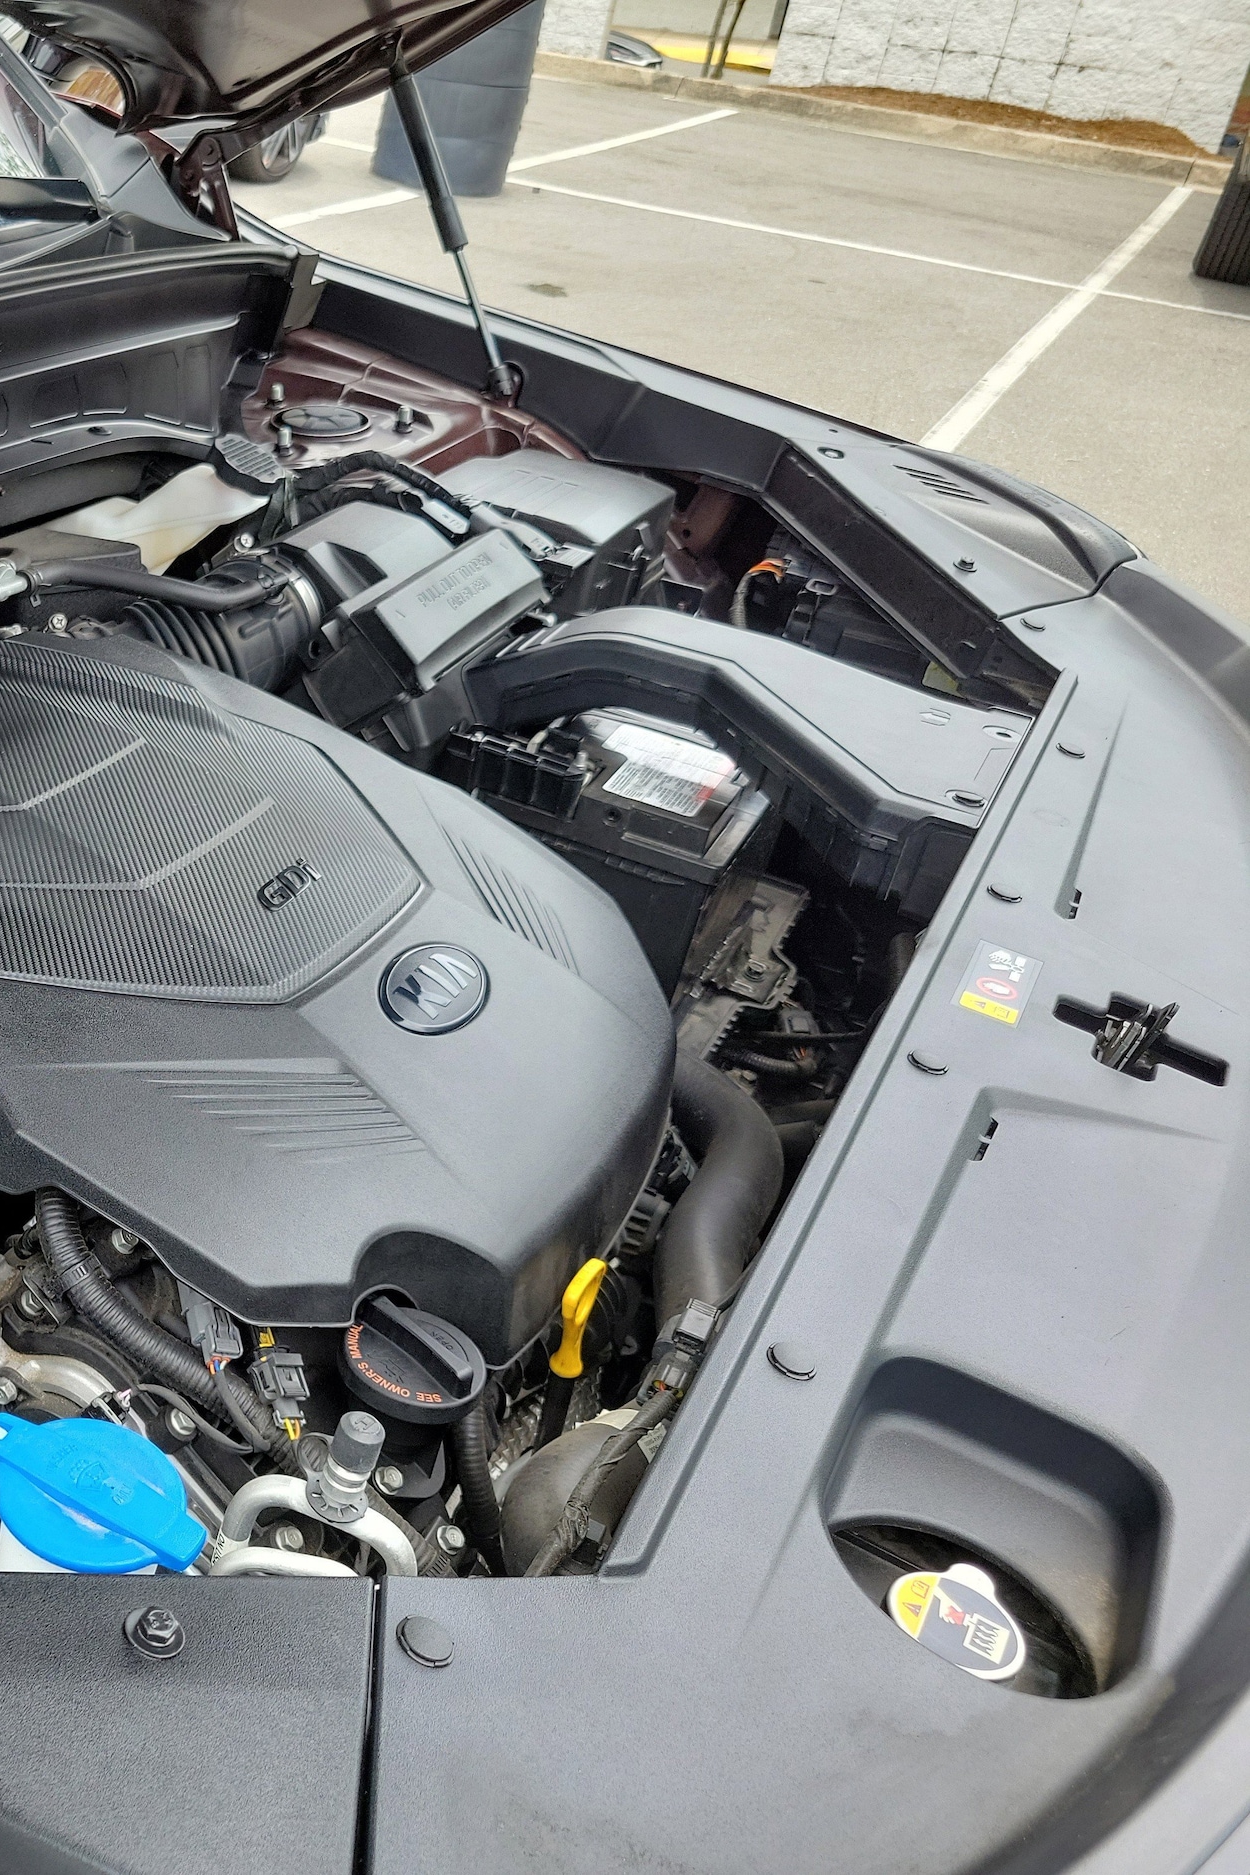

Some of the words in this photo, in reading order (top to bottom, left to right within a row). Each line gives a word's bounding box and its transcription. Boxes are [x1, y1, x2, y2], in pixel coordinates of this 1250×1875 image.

[392, 953, 478, 1020] KIA
[347, 1323, 364, 1359] MANUAL
[357, 1361, 411, 1398] OWNER'S
[416, 1391, 443, 1403] SEE
